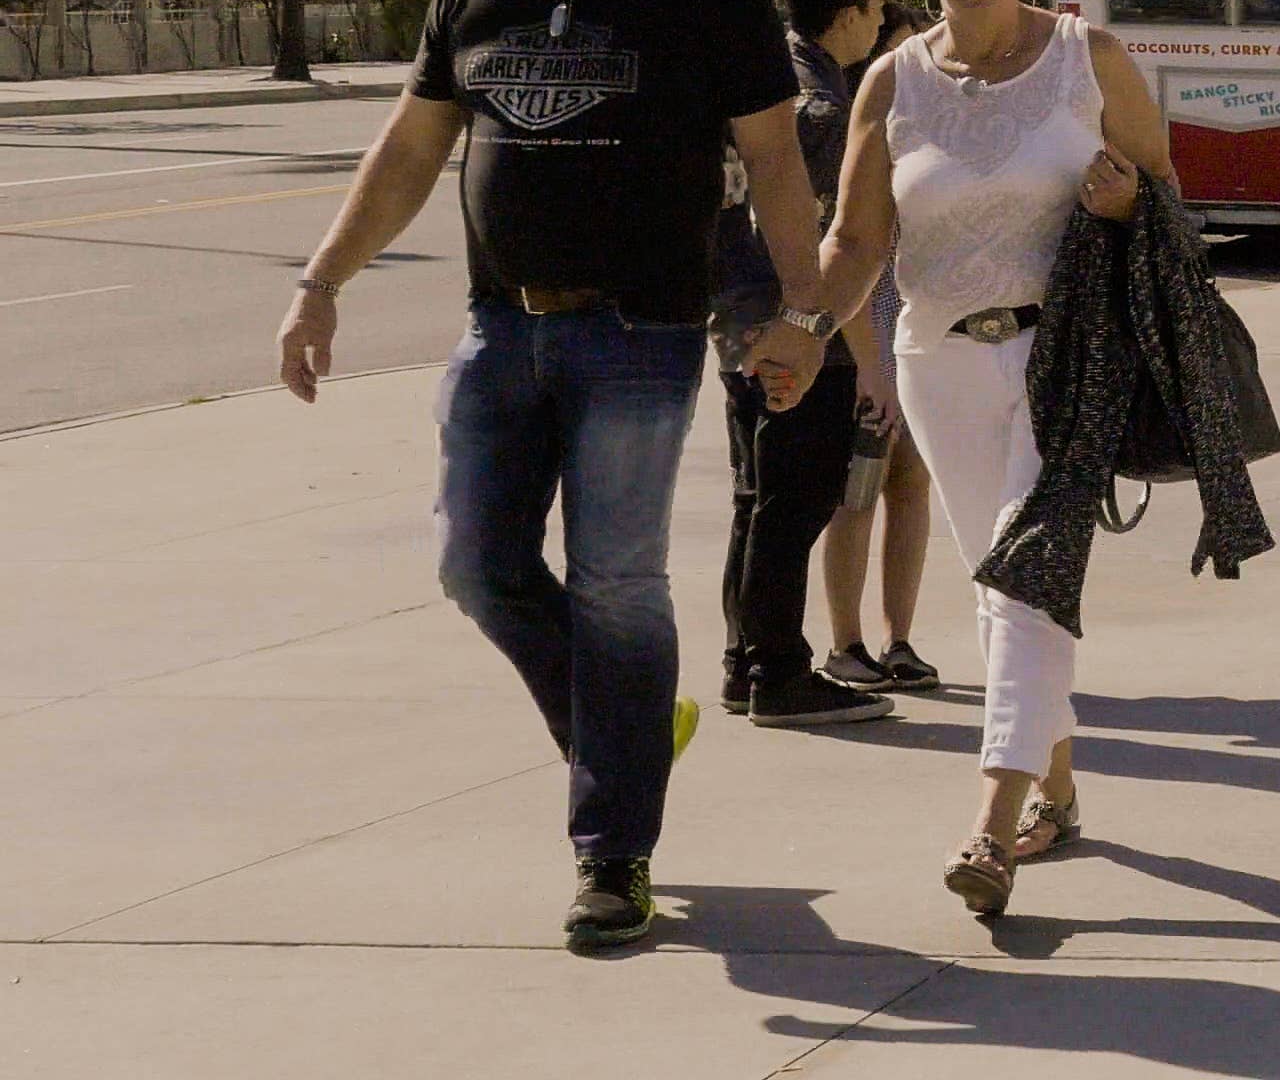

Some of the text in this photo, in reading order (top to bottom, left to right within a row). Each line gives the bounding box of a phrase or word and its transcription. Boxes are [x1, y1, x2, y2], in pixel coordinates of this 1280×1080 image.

[1128, 43, 1215, 57] COCONUTS,
[1221, 44, 1272, 57] CURRY
[472, 54, 627, 82] HARLEY-DAVIDSON
[1180, 83, 1239, 101] MANGO
[1223, 90, 1275, 108] STICKY
[504, 88, 583, 119] CYCLES
